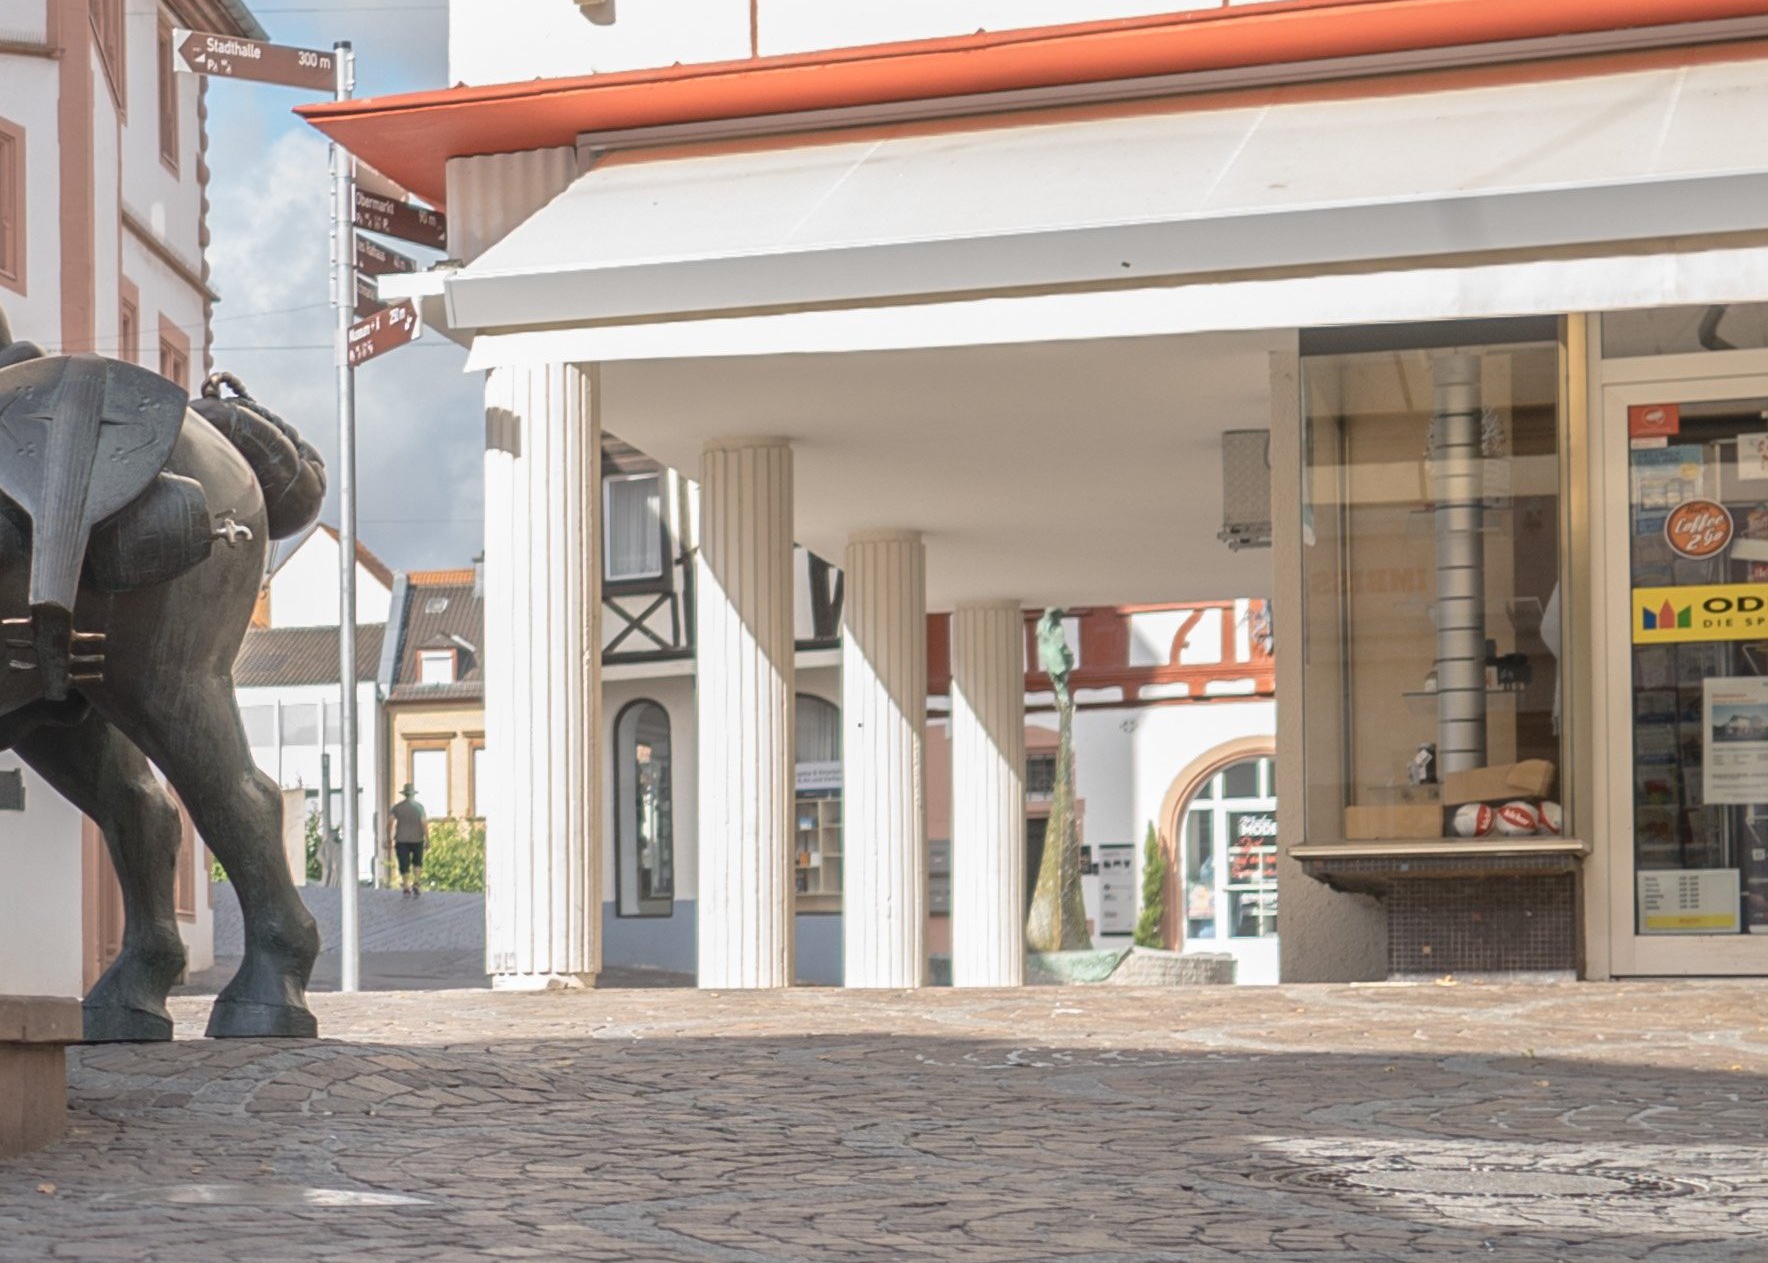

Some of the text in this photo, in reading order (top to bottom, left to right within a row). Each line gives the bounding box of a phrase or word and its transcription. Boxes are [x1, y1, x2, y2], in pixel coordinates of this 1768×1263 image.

[206, 38, 331, 69] Stadthalle 300 m
[1675, 512, 1724, 534] Coffee
[1686, 528, 1724, 551] 2 Go
[1703, 619, 1733, 628] DIE
